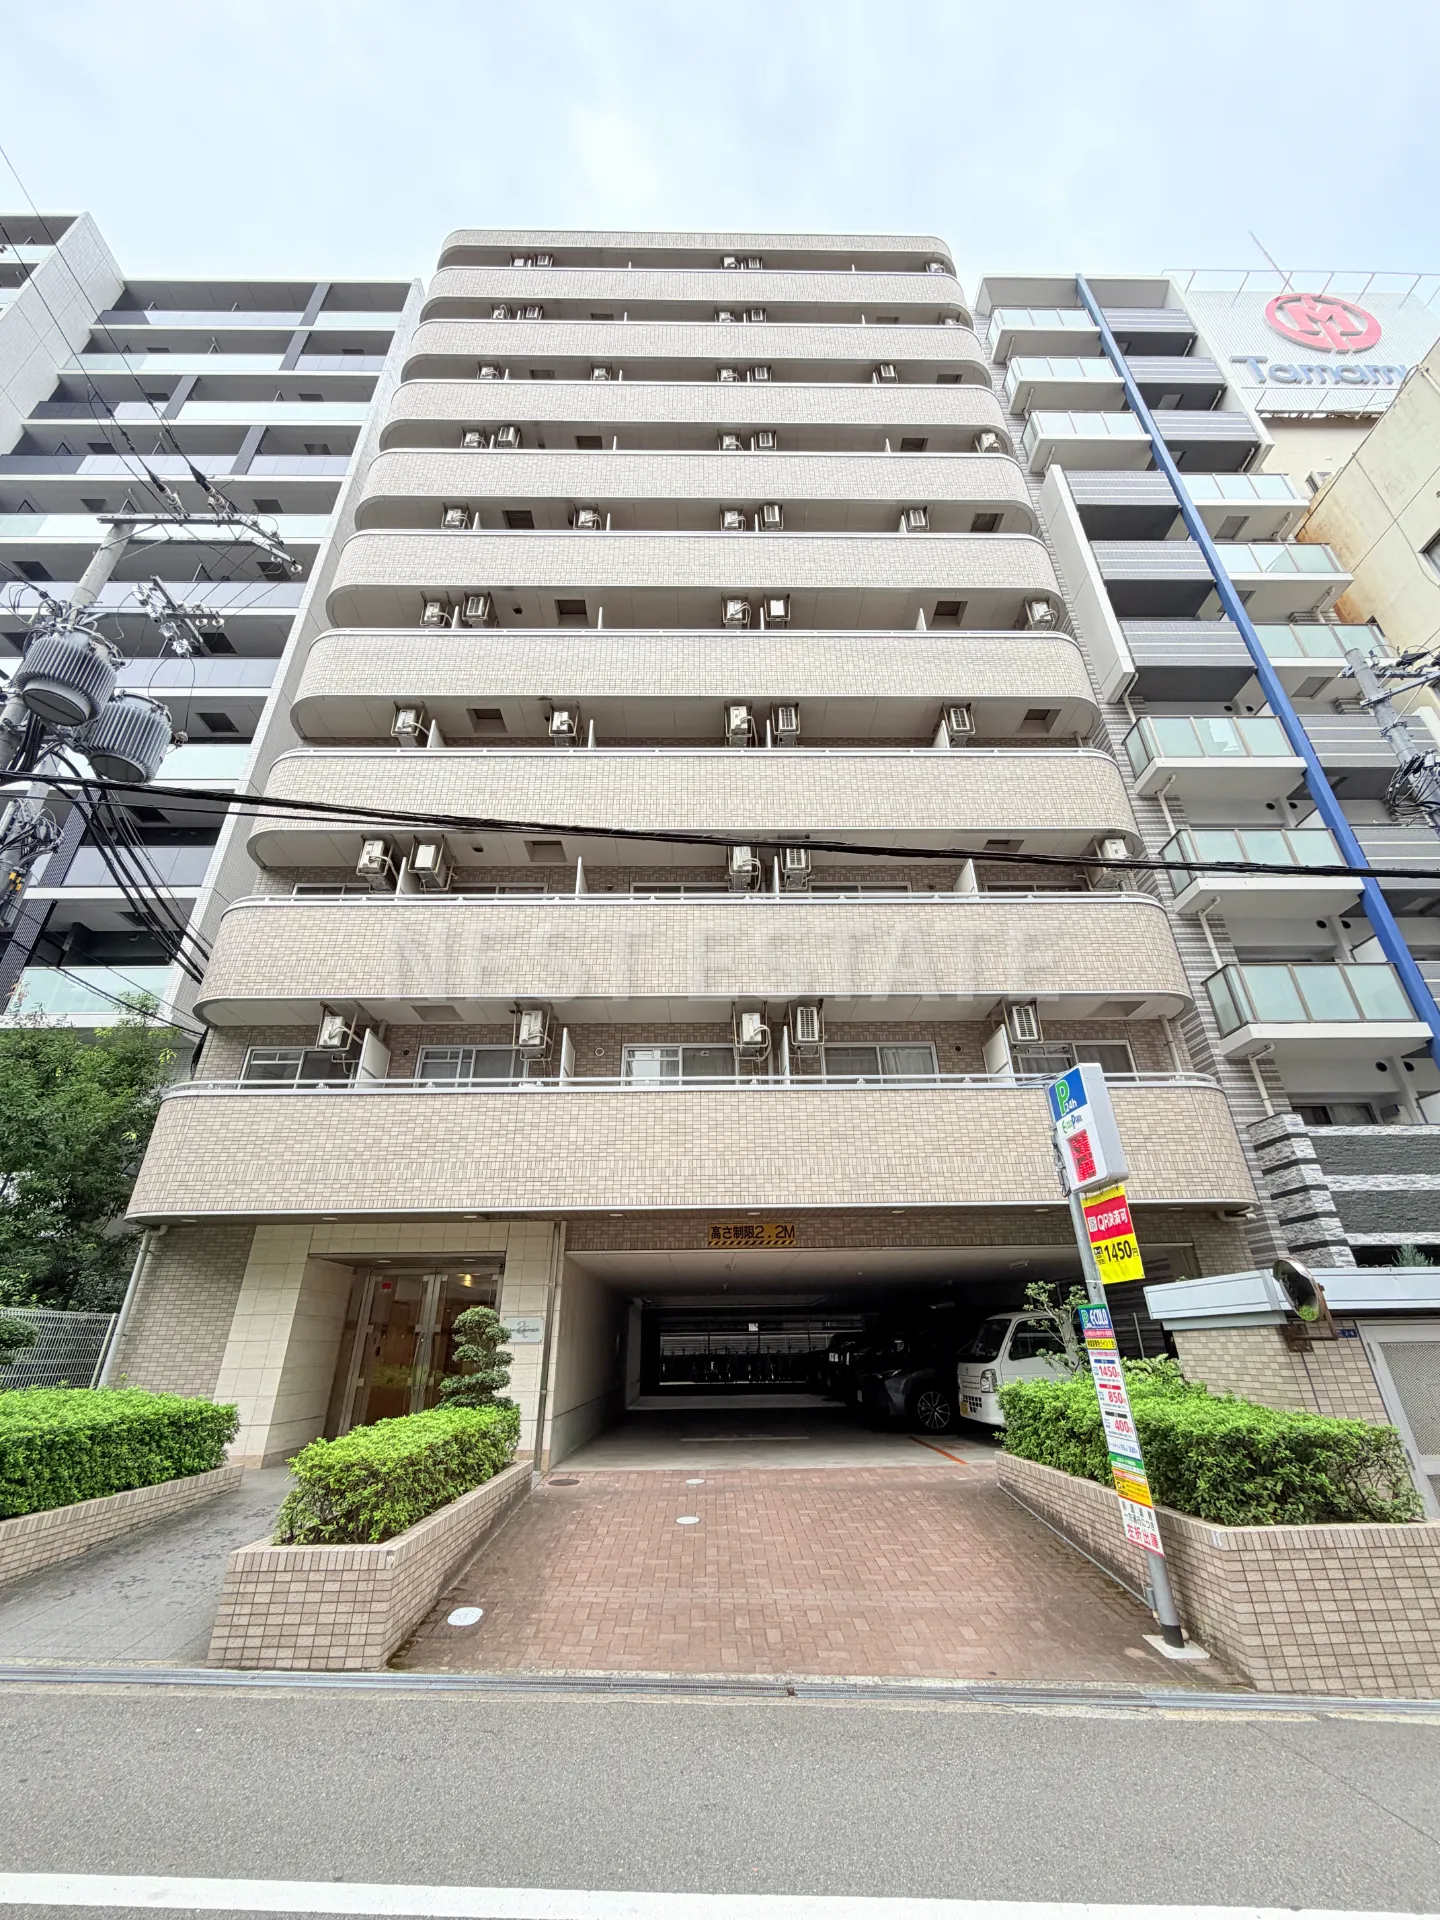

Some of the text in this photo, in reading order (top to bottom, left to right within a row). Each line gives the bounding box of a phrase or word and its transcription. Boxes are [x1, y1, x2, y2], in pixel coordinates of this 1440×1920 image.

[1055, 1079, 1070, 1116] P
[1065, 1099, 1078, 1112] 24h
[1098, 1208, 1128, 1231] QR決済可
[1127, 1524, 1159, 1549] 左折出庫
